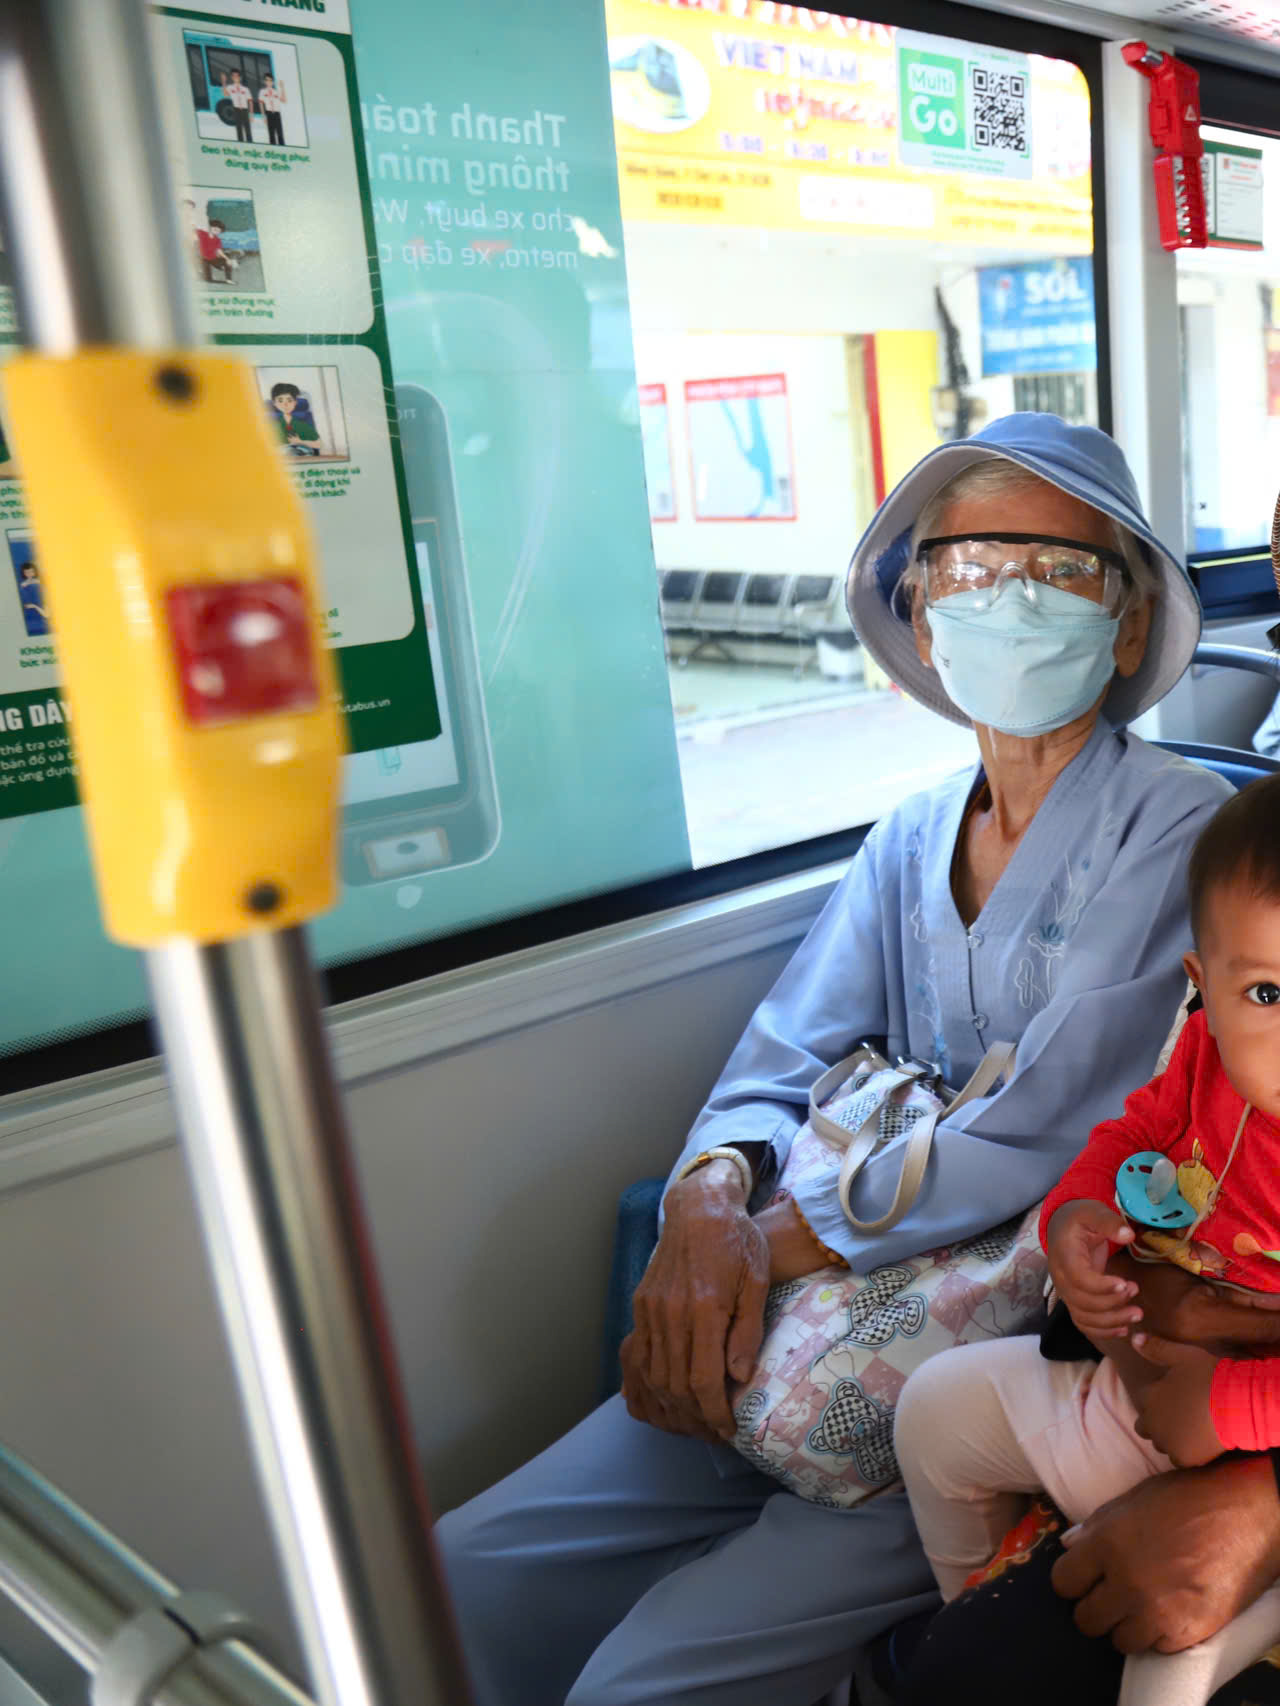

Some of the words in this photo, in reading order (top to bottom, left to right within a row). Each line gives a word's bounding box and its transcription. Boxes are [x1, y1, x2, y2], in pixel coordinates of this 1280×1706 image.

[911, 68, 954, 93] Multi
[909, 95, 958, 137] Go
[25, 741, 45, 752] tra
[49, 750, 65, 763] và
